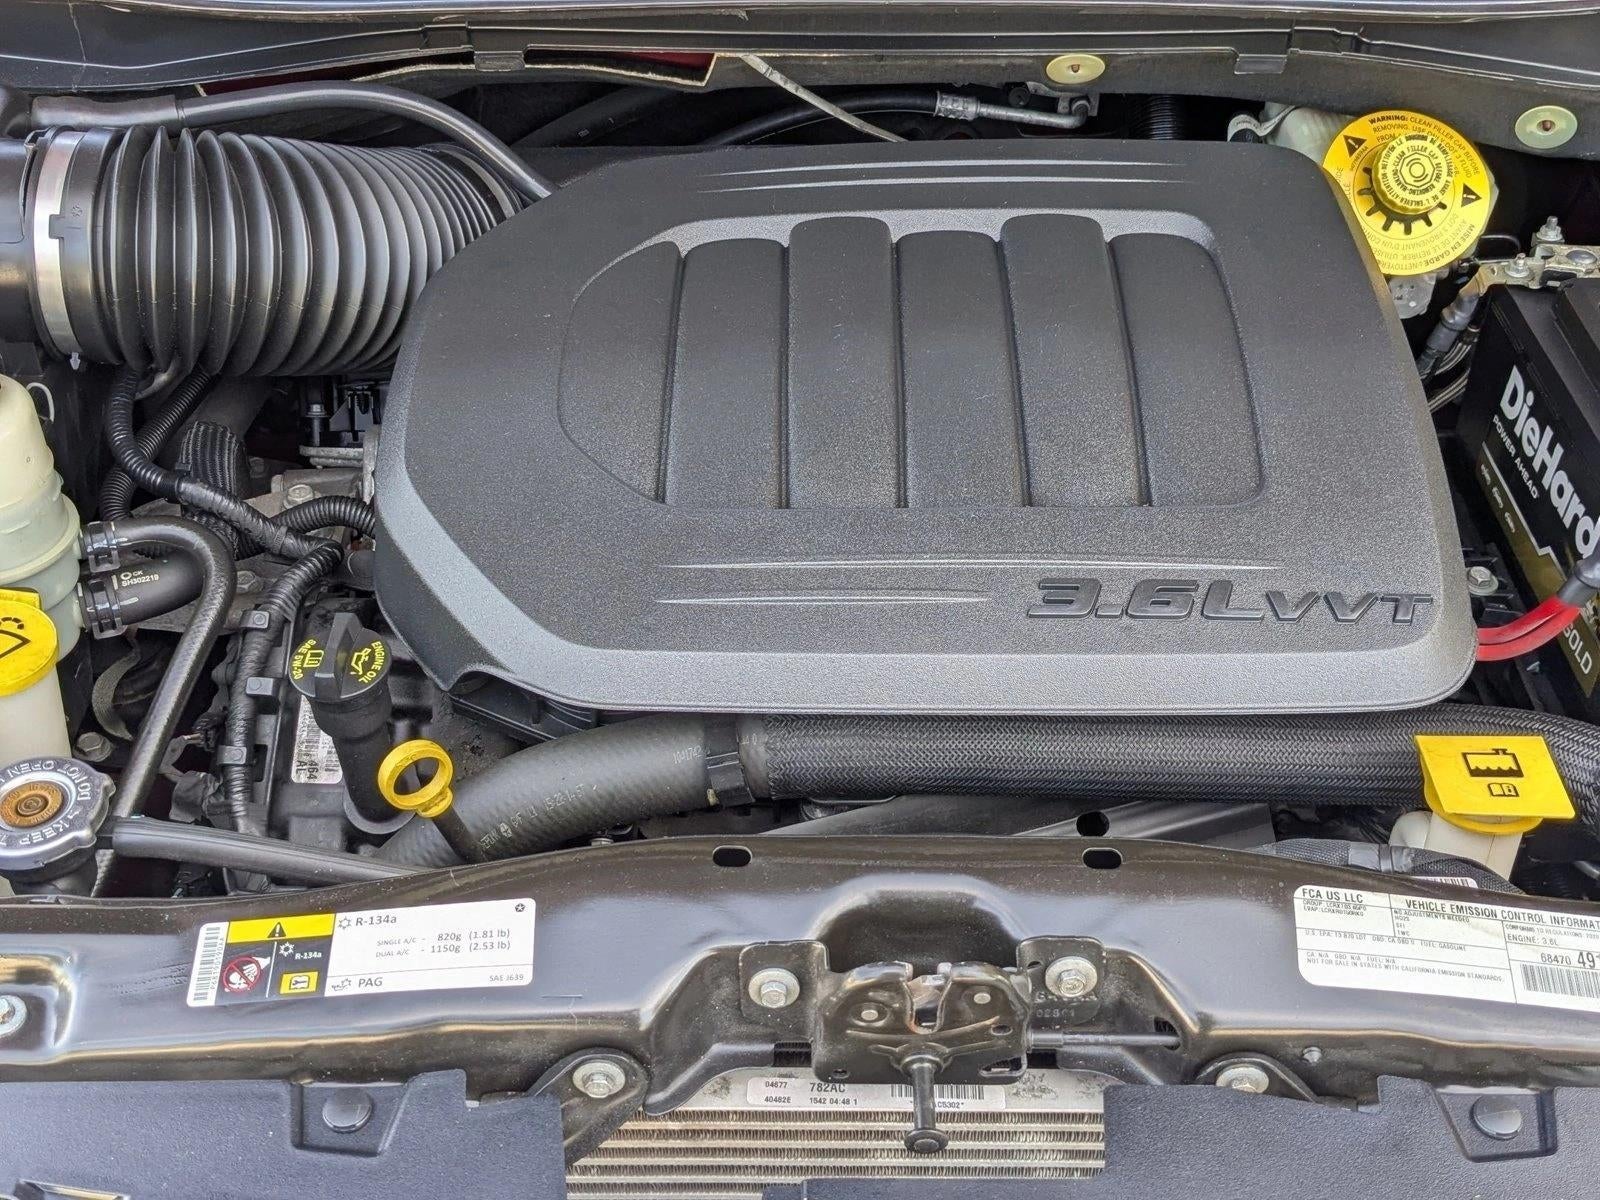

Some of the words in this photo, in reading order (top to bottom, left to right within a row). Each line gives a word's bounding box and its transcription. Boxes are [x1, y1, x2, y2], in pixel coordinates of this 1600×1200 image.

[1368, 115, 1408, 125] WARNING:
[1410, 116, 1432, 128] CLEAN
[1433, 125, 1455, 140] FILLER
[1453, 139, 1466, 151] CAP
[1464, 151, 1480, 176] BEFORE
[1461, 223, 1475, 242] MISE
[1451, 242, 1461, 252] EN
[1492, 414, 1516, 457] POWER
[1514, 457, 1538, 499] AHEAD
[1499, 365, 1600, 559] DieHard
[1027, 577, 1264, 620] 3.6L
[1265, 590, 1433, 625] VVT
[298, 638, 317, 654] SAE
[1563, 624, 1593, 675] GOLD
[371, 641, 385, 670] ENGINE
[358, 671, 376, 684] OIL
[7, 760, 55, 778] OPEN
[77, 783, 92, 800] DO
[20, 820, 69, 845] KEEP
[1302, 888, 1322, 899] FCA
[1326, 891, 1341, 900] US
[1344, 892, 1364, 903] LLC
[1405, 899, 1447, 912] VEHICLE
[1450, 903, 1498, 919] EMISSION
[1501, 910, 1547, 924] CONTROL
[355, 914, 397, 927] R-134a
[376, 939, 401, 947] SINGLE
[402, 936, 416, 945] A/C
[437, 932, 462, 942] 820g
[468, 930, 494, 940] (1.81
[497, 928, 511, 939] lb)
[1507, 933, 1540, 944] ENGINE:
[1542, 937, 1559, 946] 3.6L
[294, 952, 322, 960] R-134a
[375, 950, 394, 958] DUAL
[396, 949, 409, 957] A/C
[430, 944, 461, 954] 1150g
[469, 942, 495, 952] (2.53
[497, 940, 511, 951] lb)
[1540, 952, 1572, 965] 68470
[506, 974, 524, 982] J639
[1401, 965, 1436, 974] CALIFORNIA
[1437, 969, 1466, 977] EMISSION
[358, 976, 383, 987] PAG
[810, 1083, 846, 1093] 782AC
